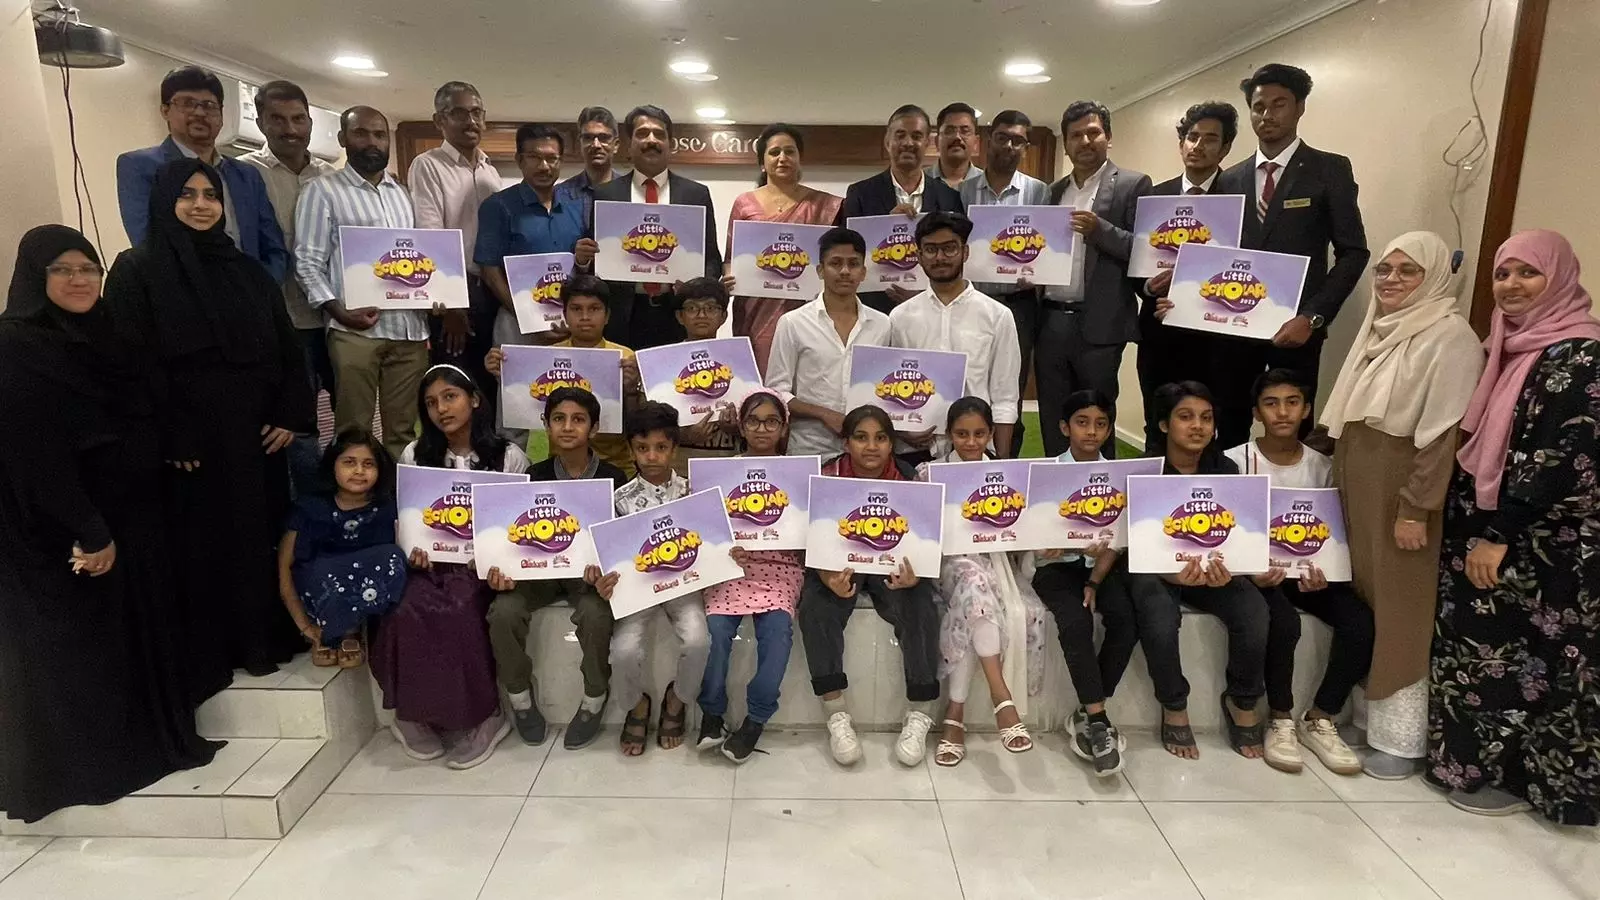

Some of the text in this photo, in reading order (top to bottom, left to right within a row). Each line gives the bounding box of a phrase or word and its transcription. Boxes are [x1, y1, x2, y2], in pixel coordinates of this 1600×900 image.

[638, 225, 663, 233] Little
[1168, 219, 1196, 227] Little
[622, 233, 677, 250] SCHOLAR
[887, 235, 911, 243] Little
[1150, 226, 1212, 245] SCHOLAR
[991, 234, 1045, 252] SCHOLAR
[390, 250, 418, 258] Little
[872, 243, 918, 262] SCHOLA
[756, 251, 809, 268] SCHOLAR
[374, 258, 436, 276] SCHOLAR
[543, 273, 567, 282] Little
[1222, 272, 1252, 281] Little
[1200, 282, 1267, 300] SCHOLAR
[688, 360, 715, 372] Little
[547, 370, 575, 379] Little
[675, 366, 733, 393] SCHOLAR
[894, 371, 921, 379] Little
[876, 380, 935, 397] SCHOLAR
[740, 483, 770, 492] Little
[979, 486, 1008, 496] Little
[1081, 486, 1112, 496] Little
[444, 496, 472, 505] Littl
[961, 492, 1026, 519] SCHOLAR
[1059, 493, 1127, 517] SCHOLAR
[528, 508, 560, 518] Little
[860, 506, 891, 516] Little
[1184, 502, 1217, 512] Little
[1163, 511, 1236, 535] SCHOLAR
[1283, 514, 1315, 523] Little
[508, 515, 580, 542] SCHOLAR
[838, 517, 909, 536] SCHOLAR
[649, 528, 680, 545] Little
[1270, 523, 1329, 543] CHOLAR
[635, 531, 702, 572] SCHOLAR
[681, 551, 695, 559] 2023
